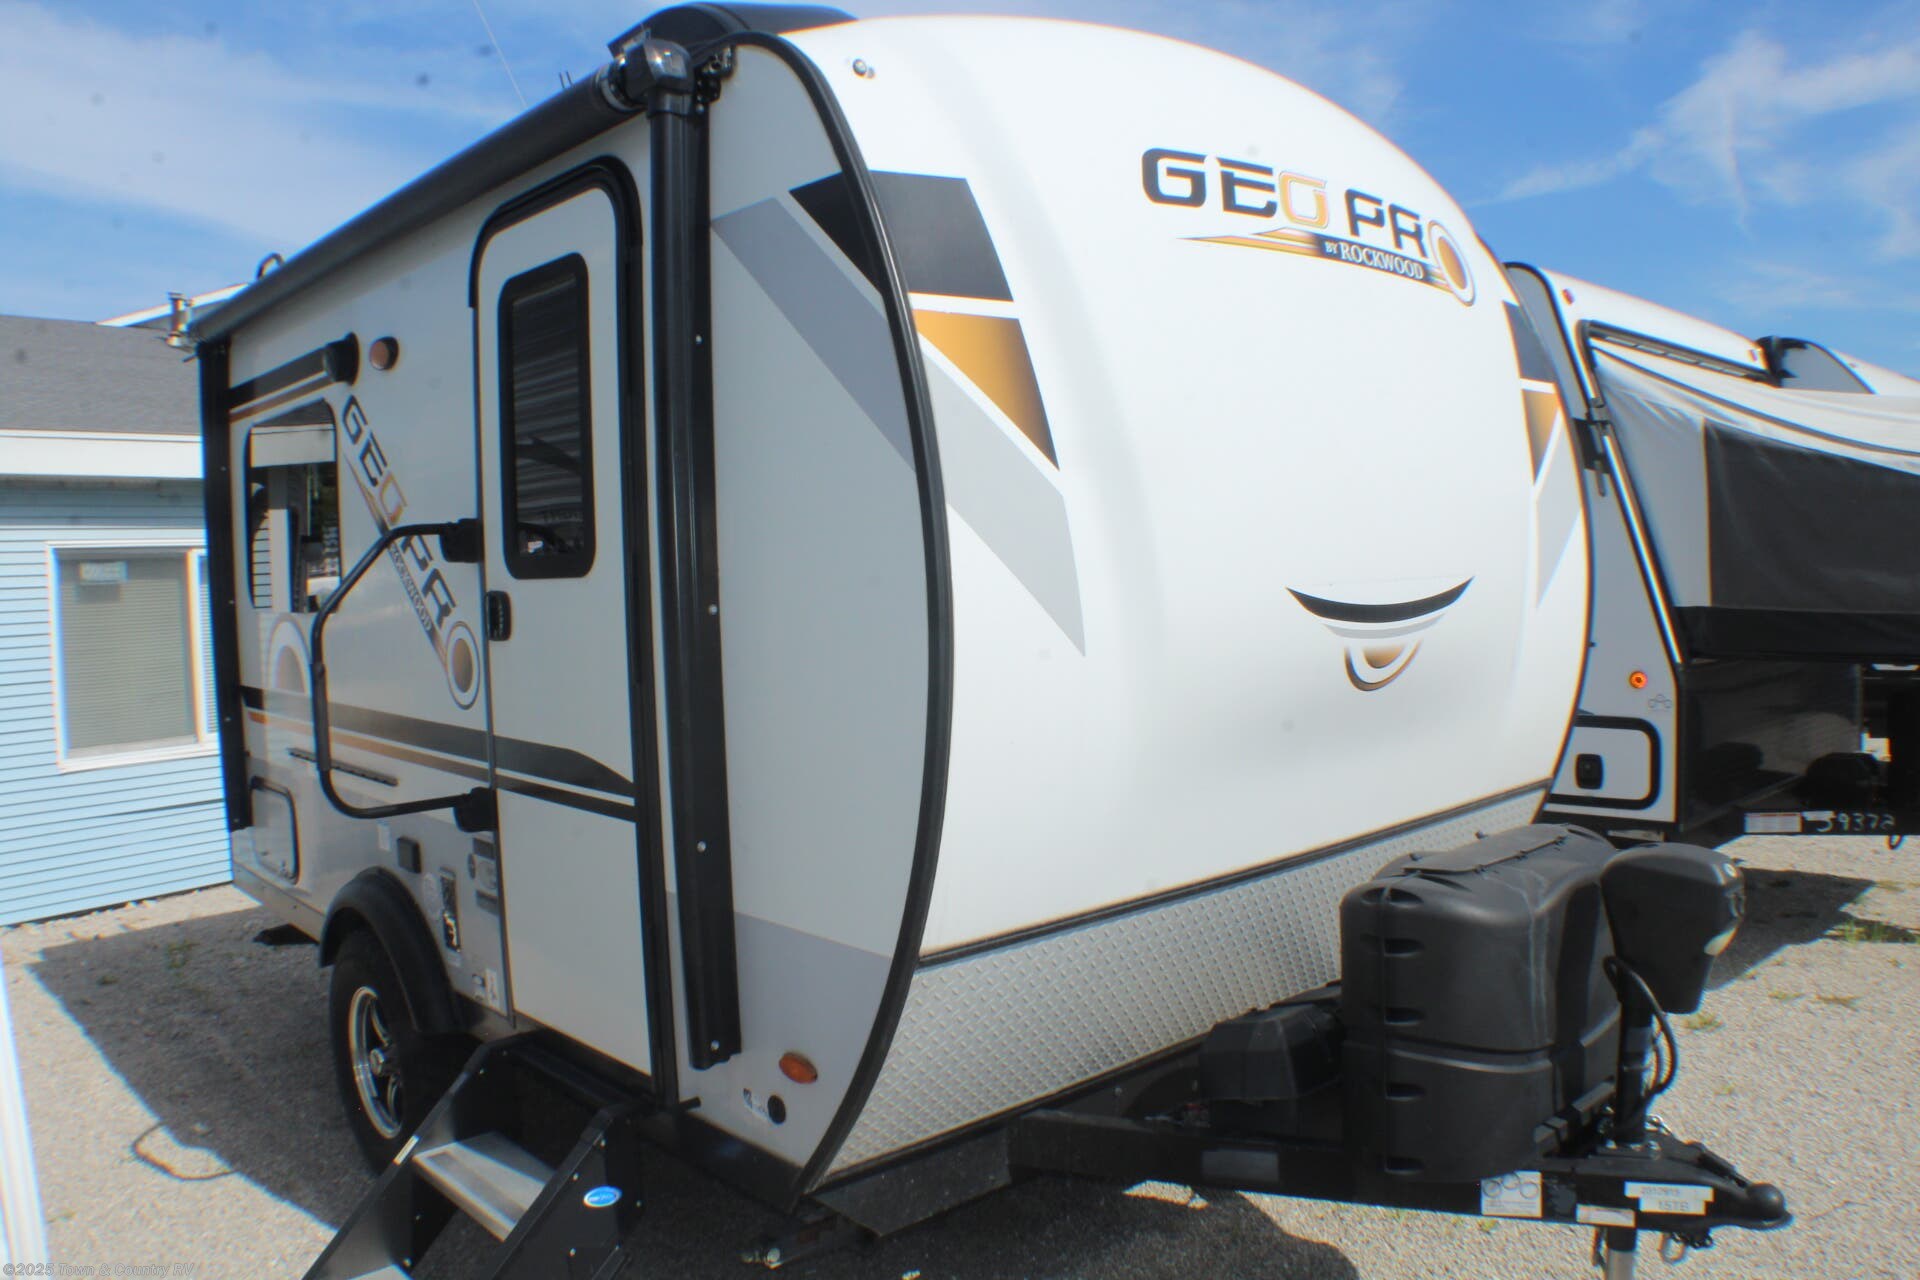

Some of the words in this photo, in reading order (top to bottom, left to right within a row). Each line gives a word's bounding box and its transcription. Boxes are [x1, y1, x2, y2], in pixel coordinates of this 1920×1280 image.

[1141, 147, 1329, 230] GEO
[1324, 241, 1339, 255] BY
[1339, 241, 1425, 280] ROCKWOOD
[341, 394, 408, 526] GEO
